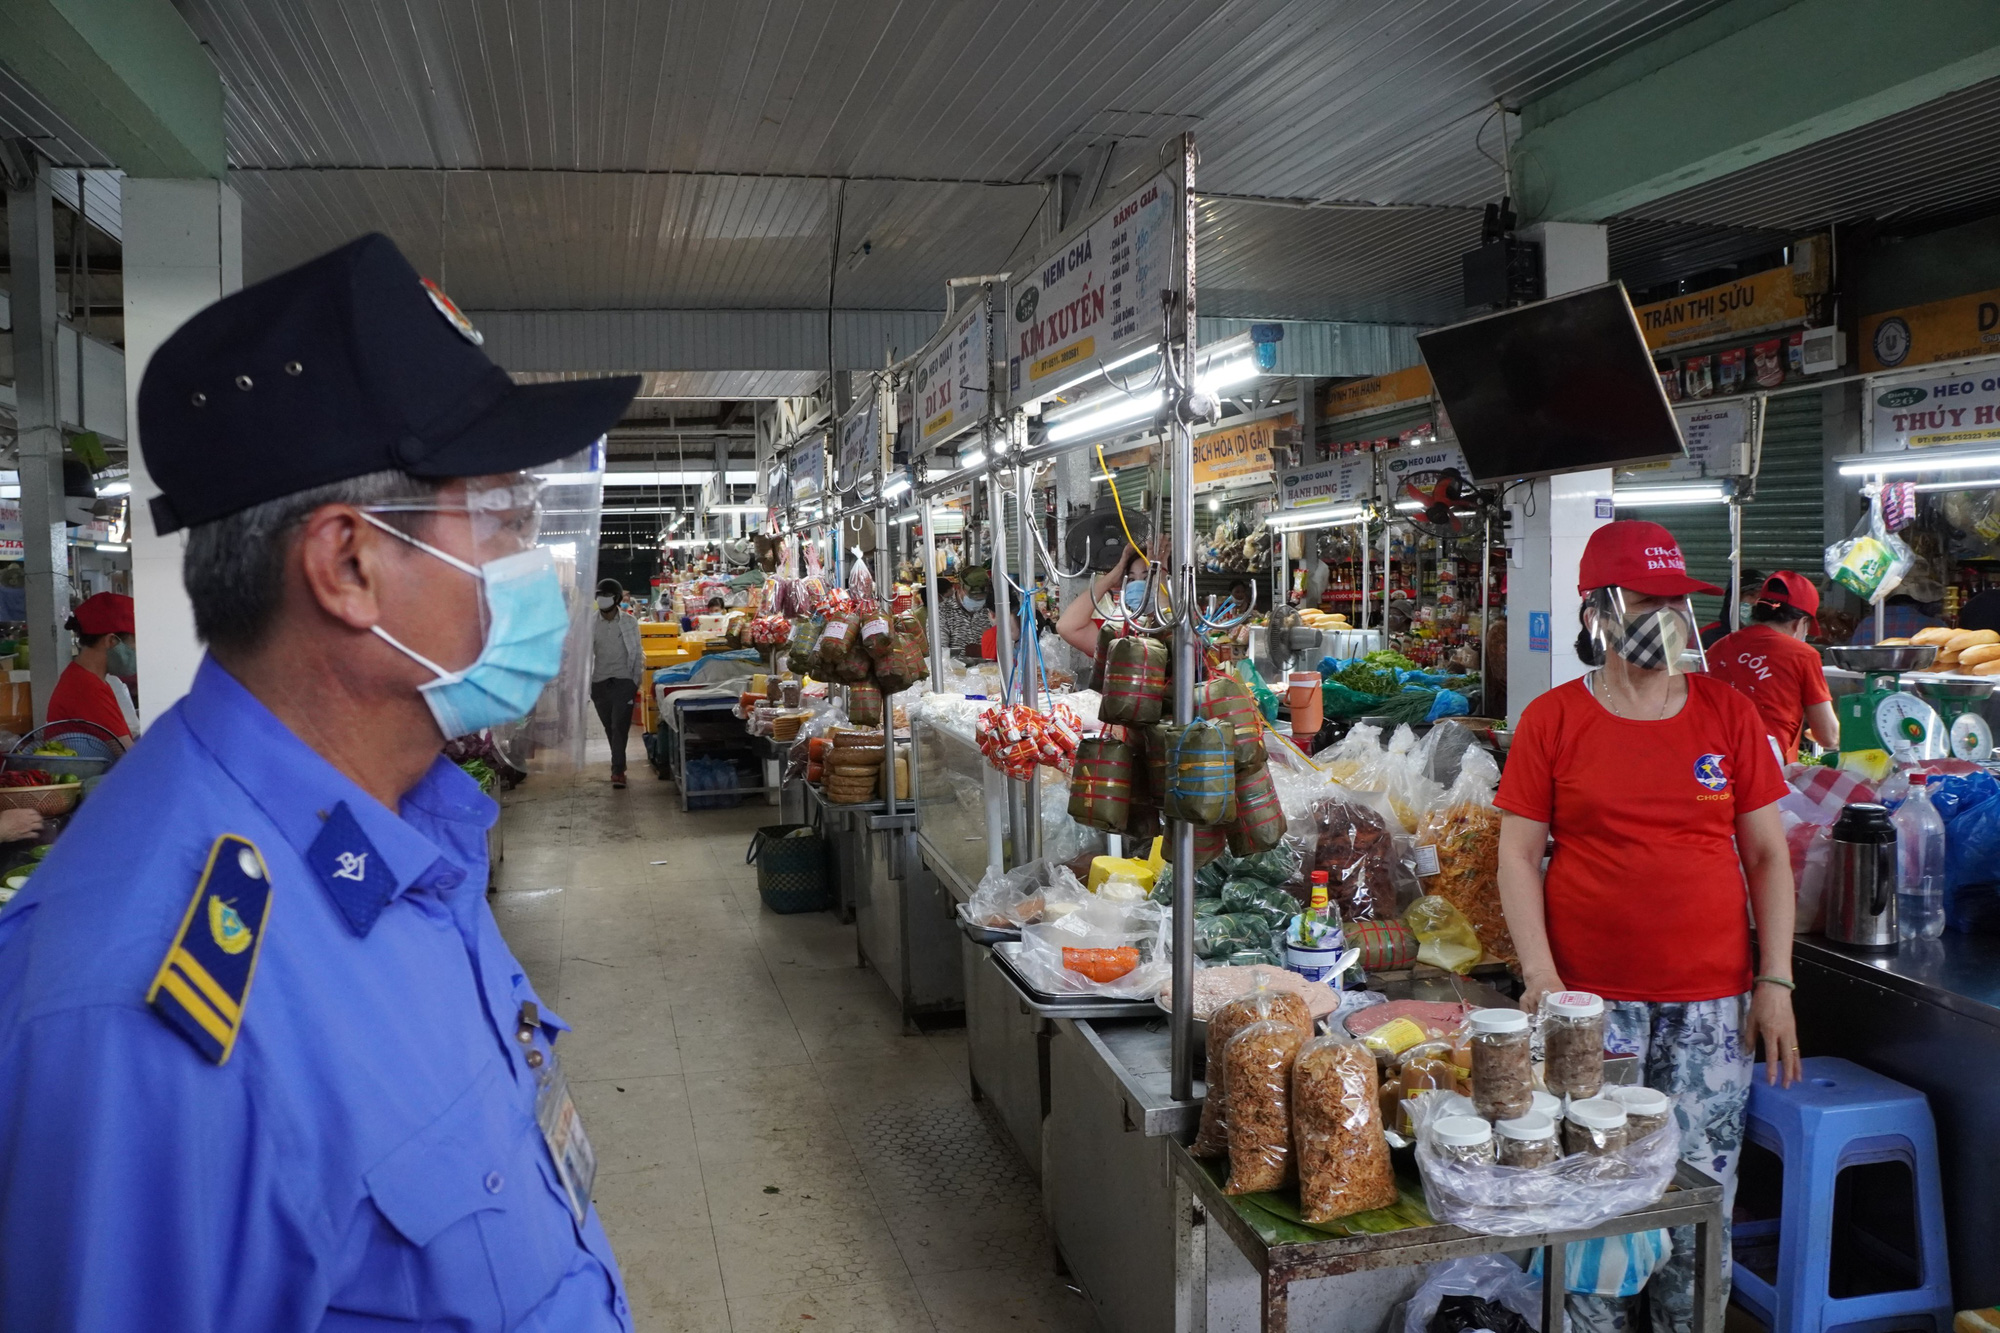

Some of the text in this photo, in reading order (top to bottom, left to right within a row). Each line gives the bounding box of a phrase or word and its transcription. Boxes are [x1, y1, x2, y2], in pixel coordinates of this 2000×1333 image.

[1113, 182, 1158, 229] BẢNG GIÁ
[1043, 229, 1092, 290] NEM CHẢ
[1020, 270, 1105, 361] KIM XUYẾN
[1687, 295, 1714, 322] THỊ
[1718, 283, 1754, 314] SỬU
[928, 341, 953, 380] HEO QUAY
[1890, 397, 1914, 407] 26
[1912, 389, 1918, 397] 7
[1933, 381, 1974, 399] HEO
[1892, 404, 1967, 432] THÚY
[1193, 441, 1213, 464] BÍCH
[1214, 436, 1234, 459] HÒA
[1235, 430, 1249, 457] (DÌ
[1250, 425, 1270, 451] GÁI)
[1408, 458, 1424, 467] HEO
[1425, 454, 1447, 465] QUAY
[1301, 473, 1314, 482] HEO
[1315, 470, 1333, 480] QUAY
[1288, 486, 1312, 501] HẠNH
[1313, 483, 1338, 496] DUNG
